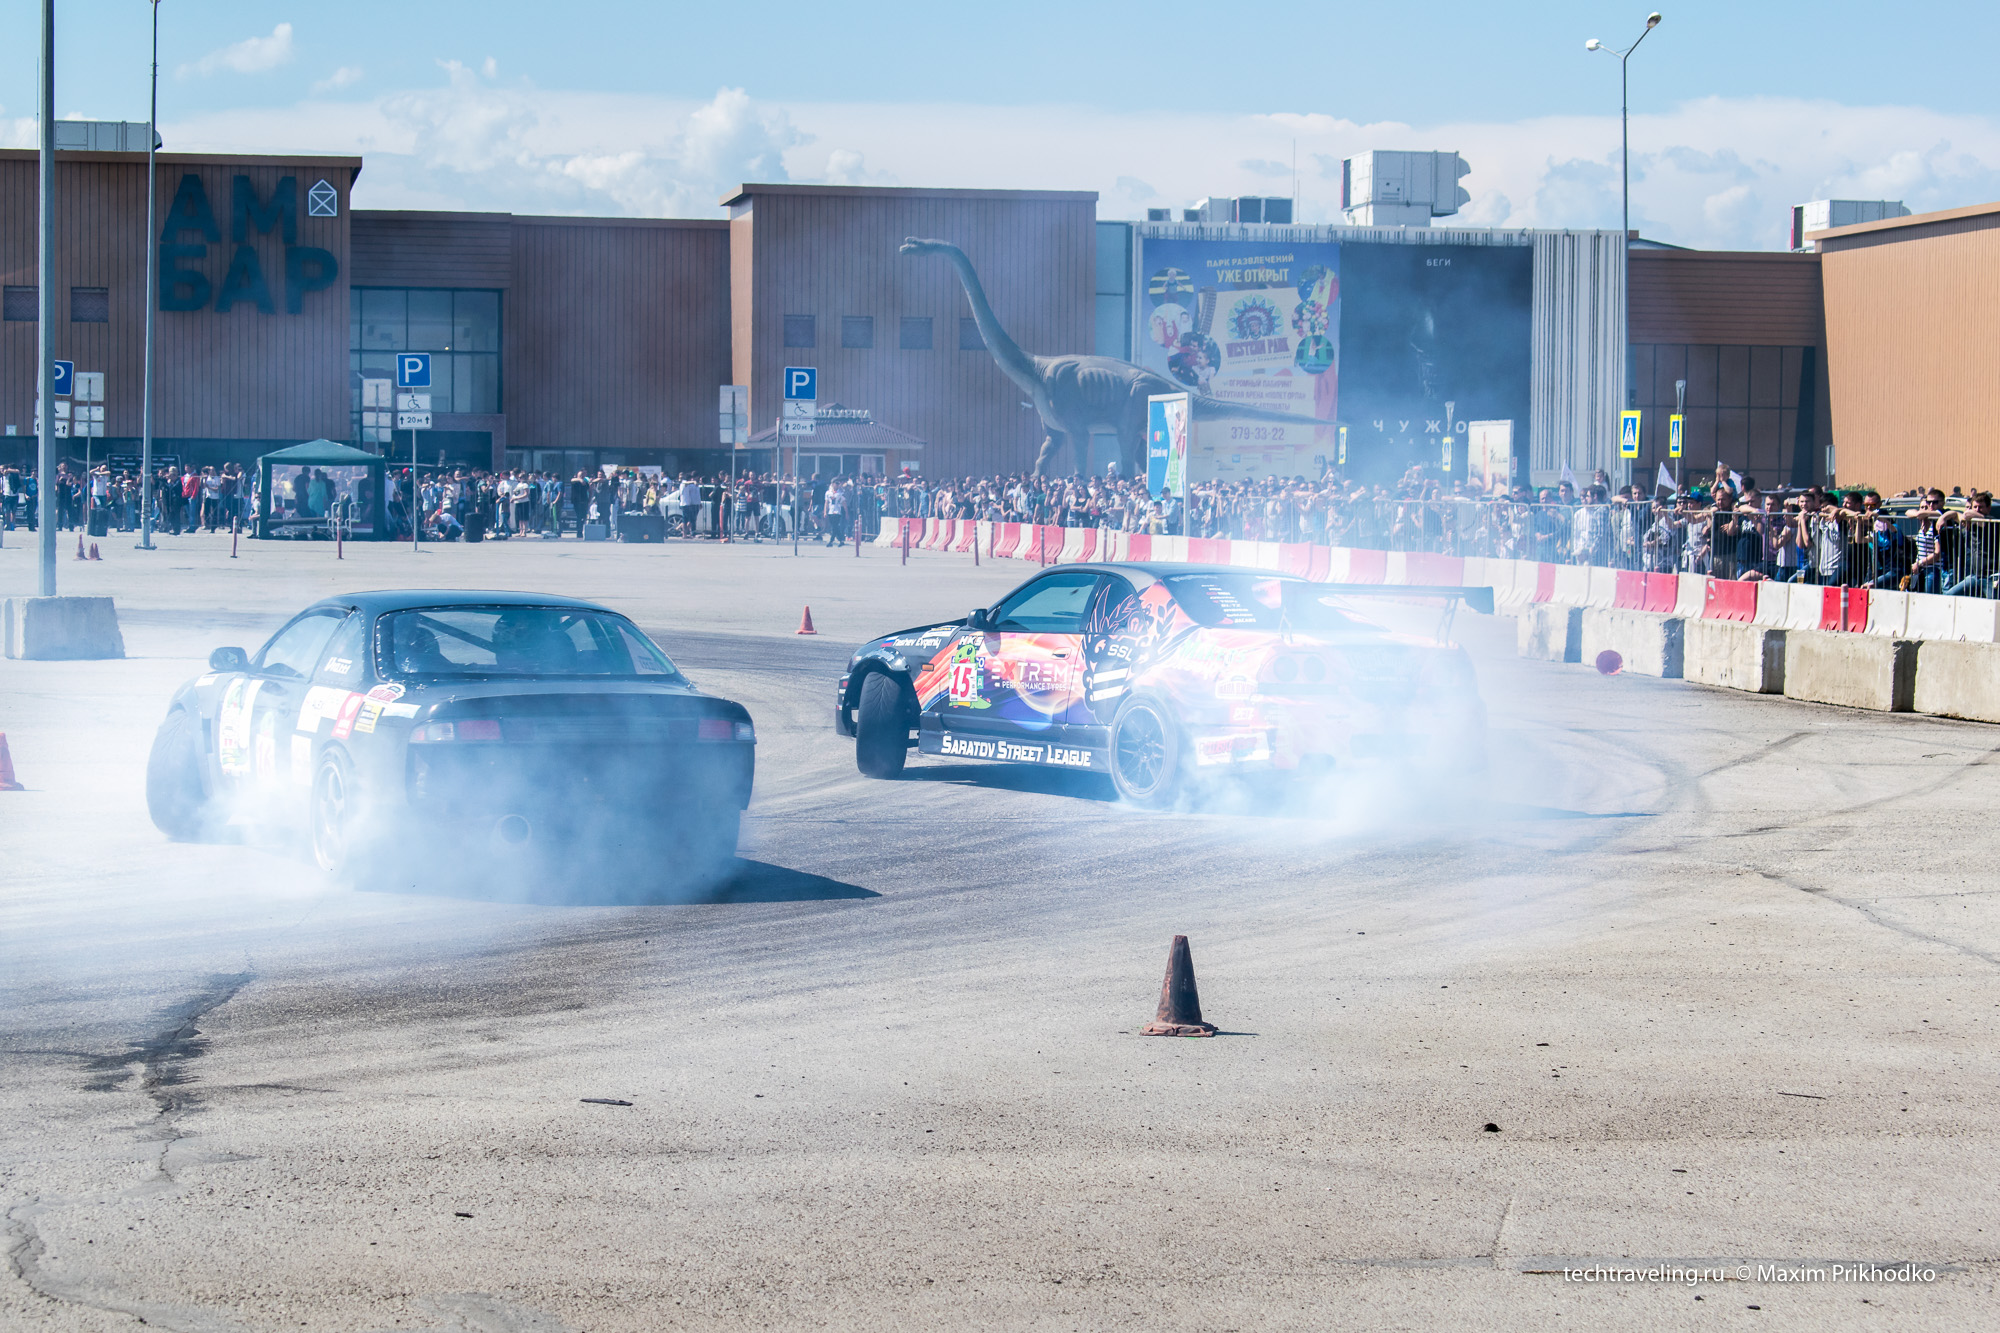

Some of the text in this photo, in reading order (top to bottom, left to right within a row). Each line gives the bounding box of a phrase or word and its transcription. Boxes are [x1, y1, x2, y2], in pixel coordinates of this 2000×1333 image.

[1206, 252, 1295, 268] ПАРК РАЗВЛЕЧЕНИЙ
[1426, 258, 1451, 267] БЕГИ
[159, 244, 338, 314] БАР
[1216, 268, 1290, 283] УЖЕ ОТКРЫТ
[404, 357, 424, 383] P
[791, 371, 810, 396] P
[1231, 426, 1285, 441] 379-33-22
[958, 635, 985, 646] HKS
[1107, 644, 1132, 662] SSL
[991, 660, 1080, 682] EXTREME
[950, 665, 972, 698] 15
[1002, 681, 1067, 691] PERFORMANCE TYRES
[941, 735, 1092, 767] SARATOV STREET LEAGUE
